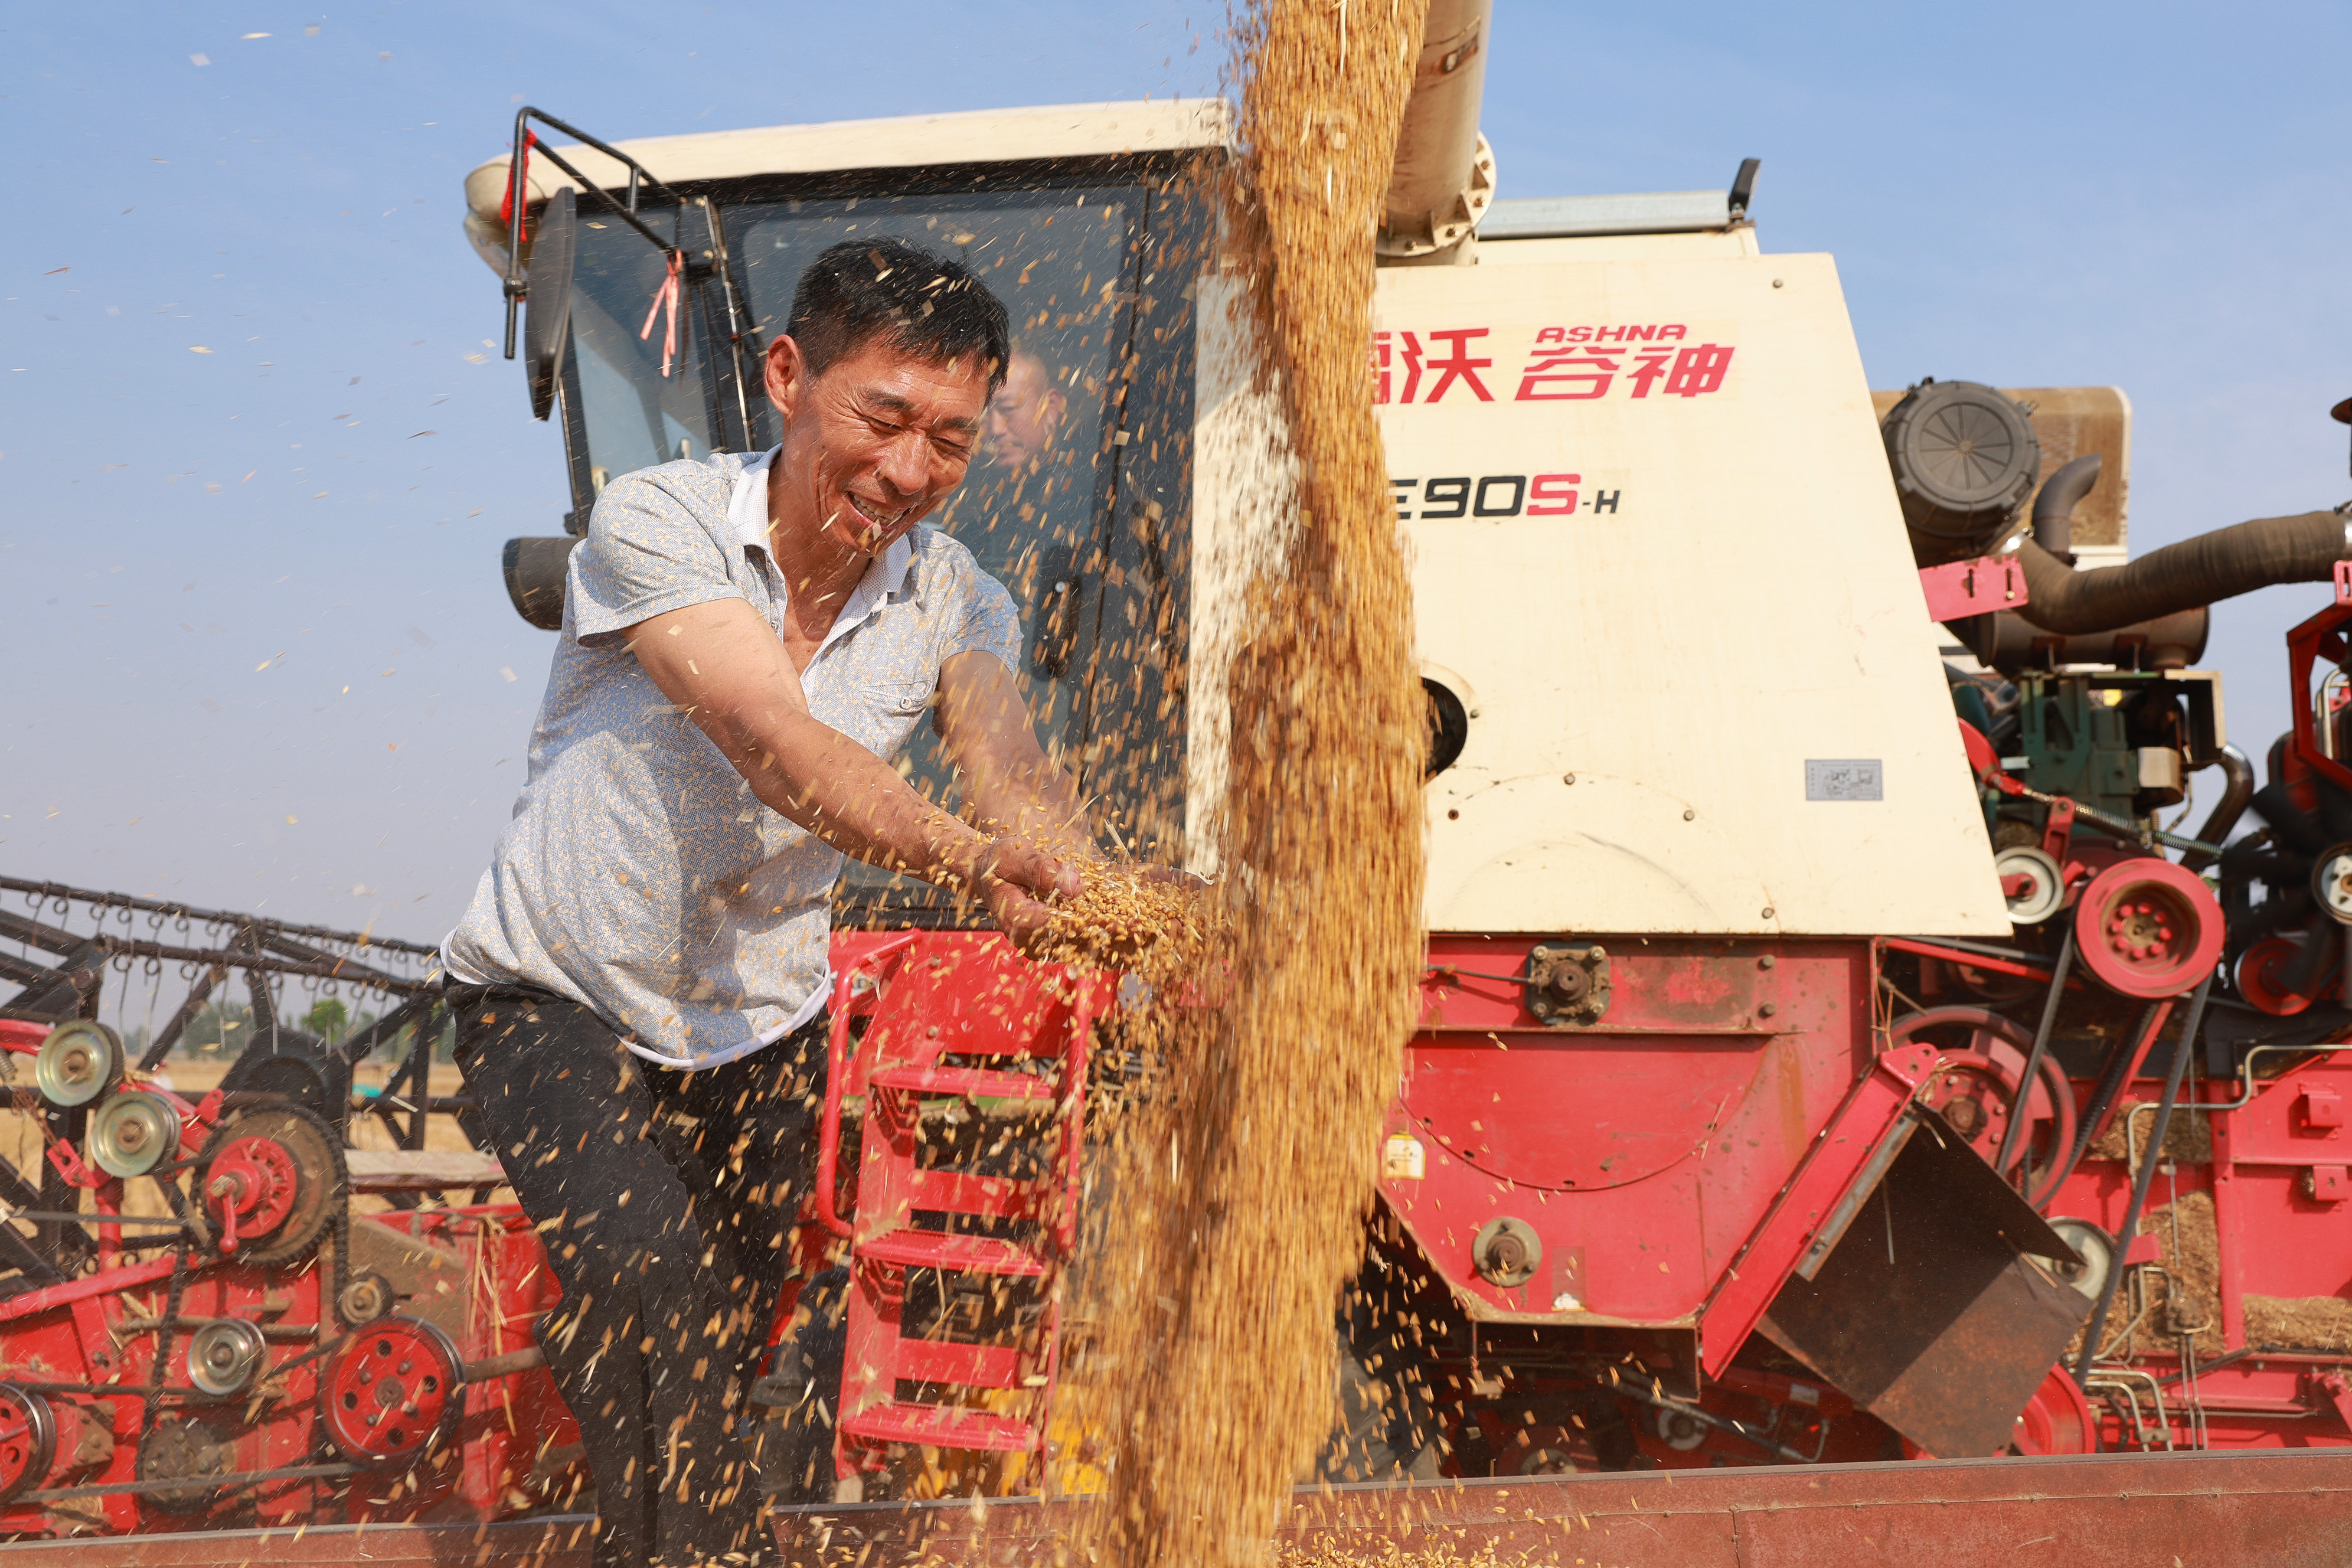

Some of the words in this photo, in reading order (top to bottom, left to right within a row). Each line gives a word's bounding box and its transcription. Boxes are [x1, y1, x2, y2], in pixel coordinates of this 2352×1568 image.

[1535, 324, 1687, 344] ASHNA
[1373, 328, 1495, 404] 沃
[1514, 344, 1735, 401] 谷神
